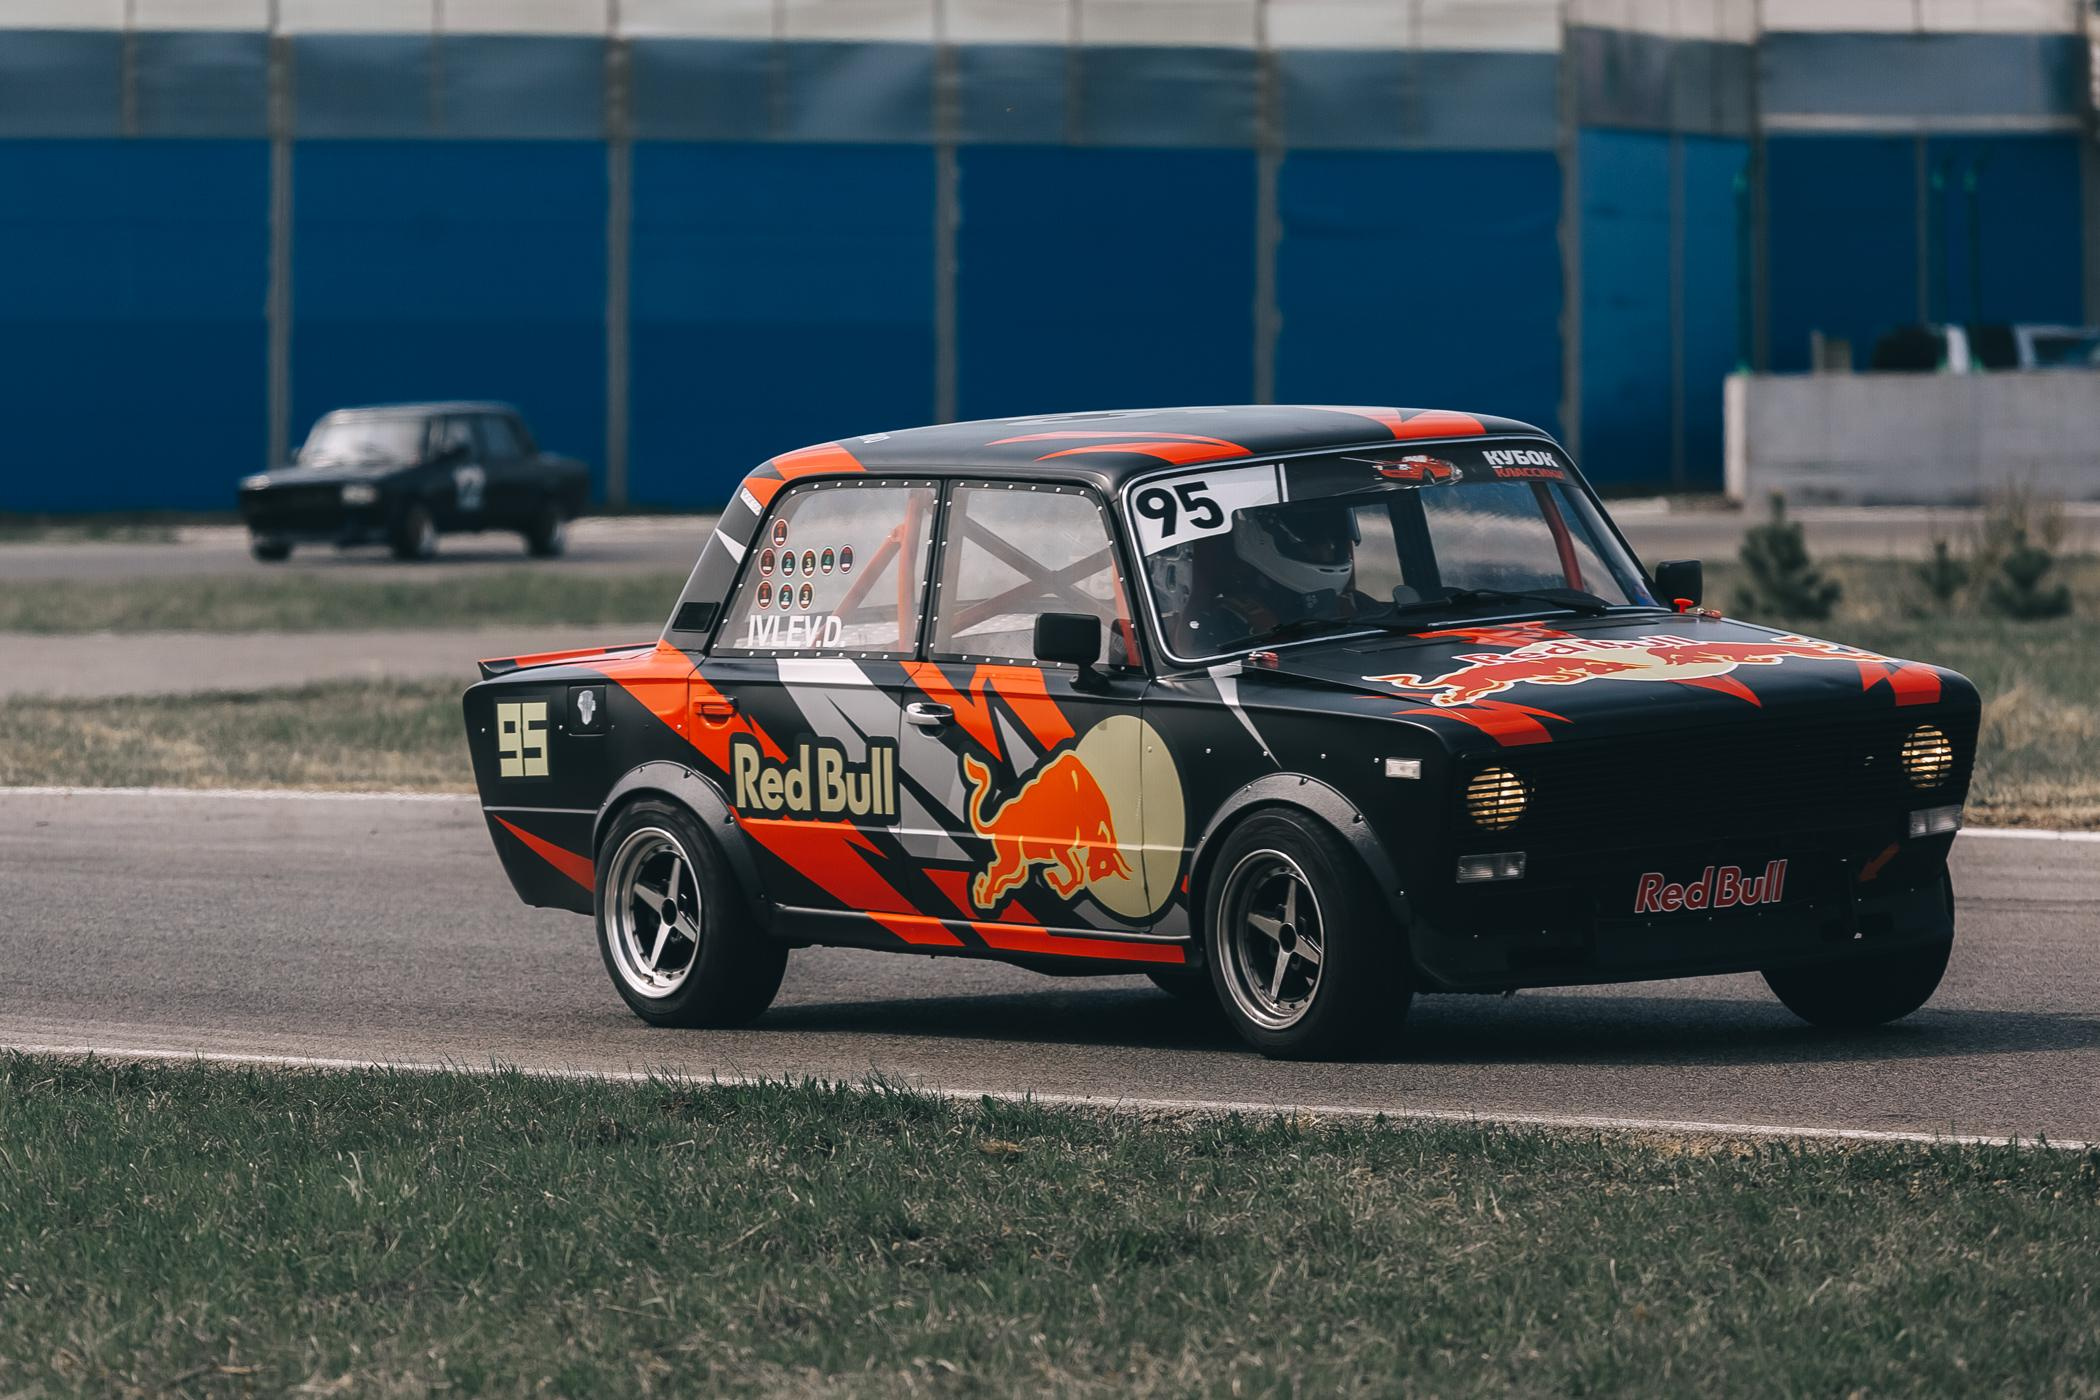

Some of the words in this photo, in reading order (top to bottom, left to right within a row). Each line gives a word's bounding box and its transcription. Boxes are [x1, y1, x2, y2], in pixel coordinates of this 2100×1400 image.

[1482, 450, 1560, 467] КУБОК
[1135, 481, 1225, 538] 95
[1453, 641, 1590, 665] Red
[1577, 635, 1699, 651] Bull
[496, 702, 550, 777] 95
[734, 742, 811, 812] Red
[818, 746, 895, 816] Bull
[1634, 866, 1715, 913] Red
[1713, 859, 1788, 908] Bull
